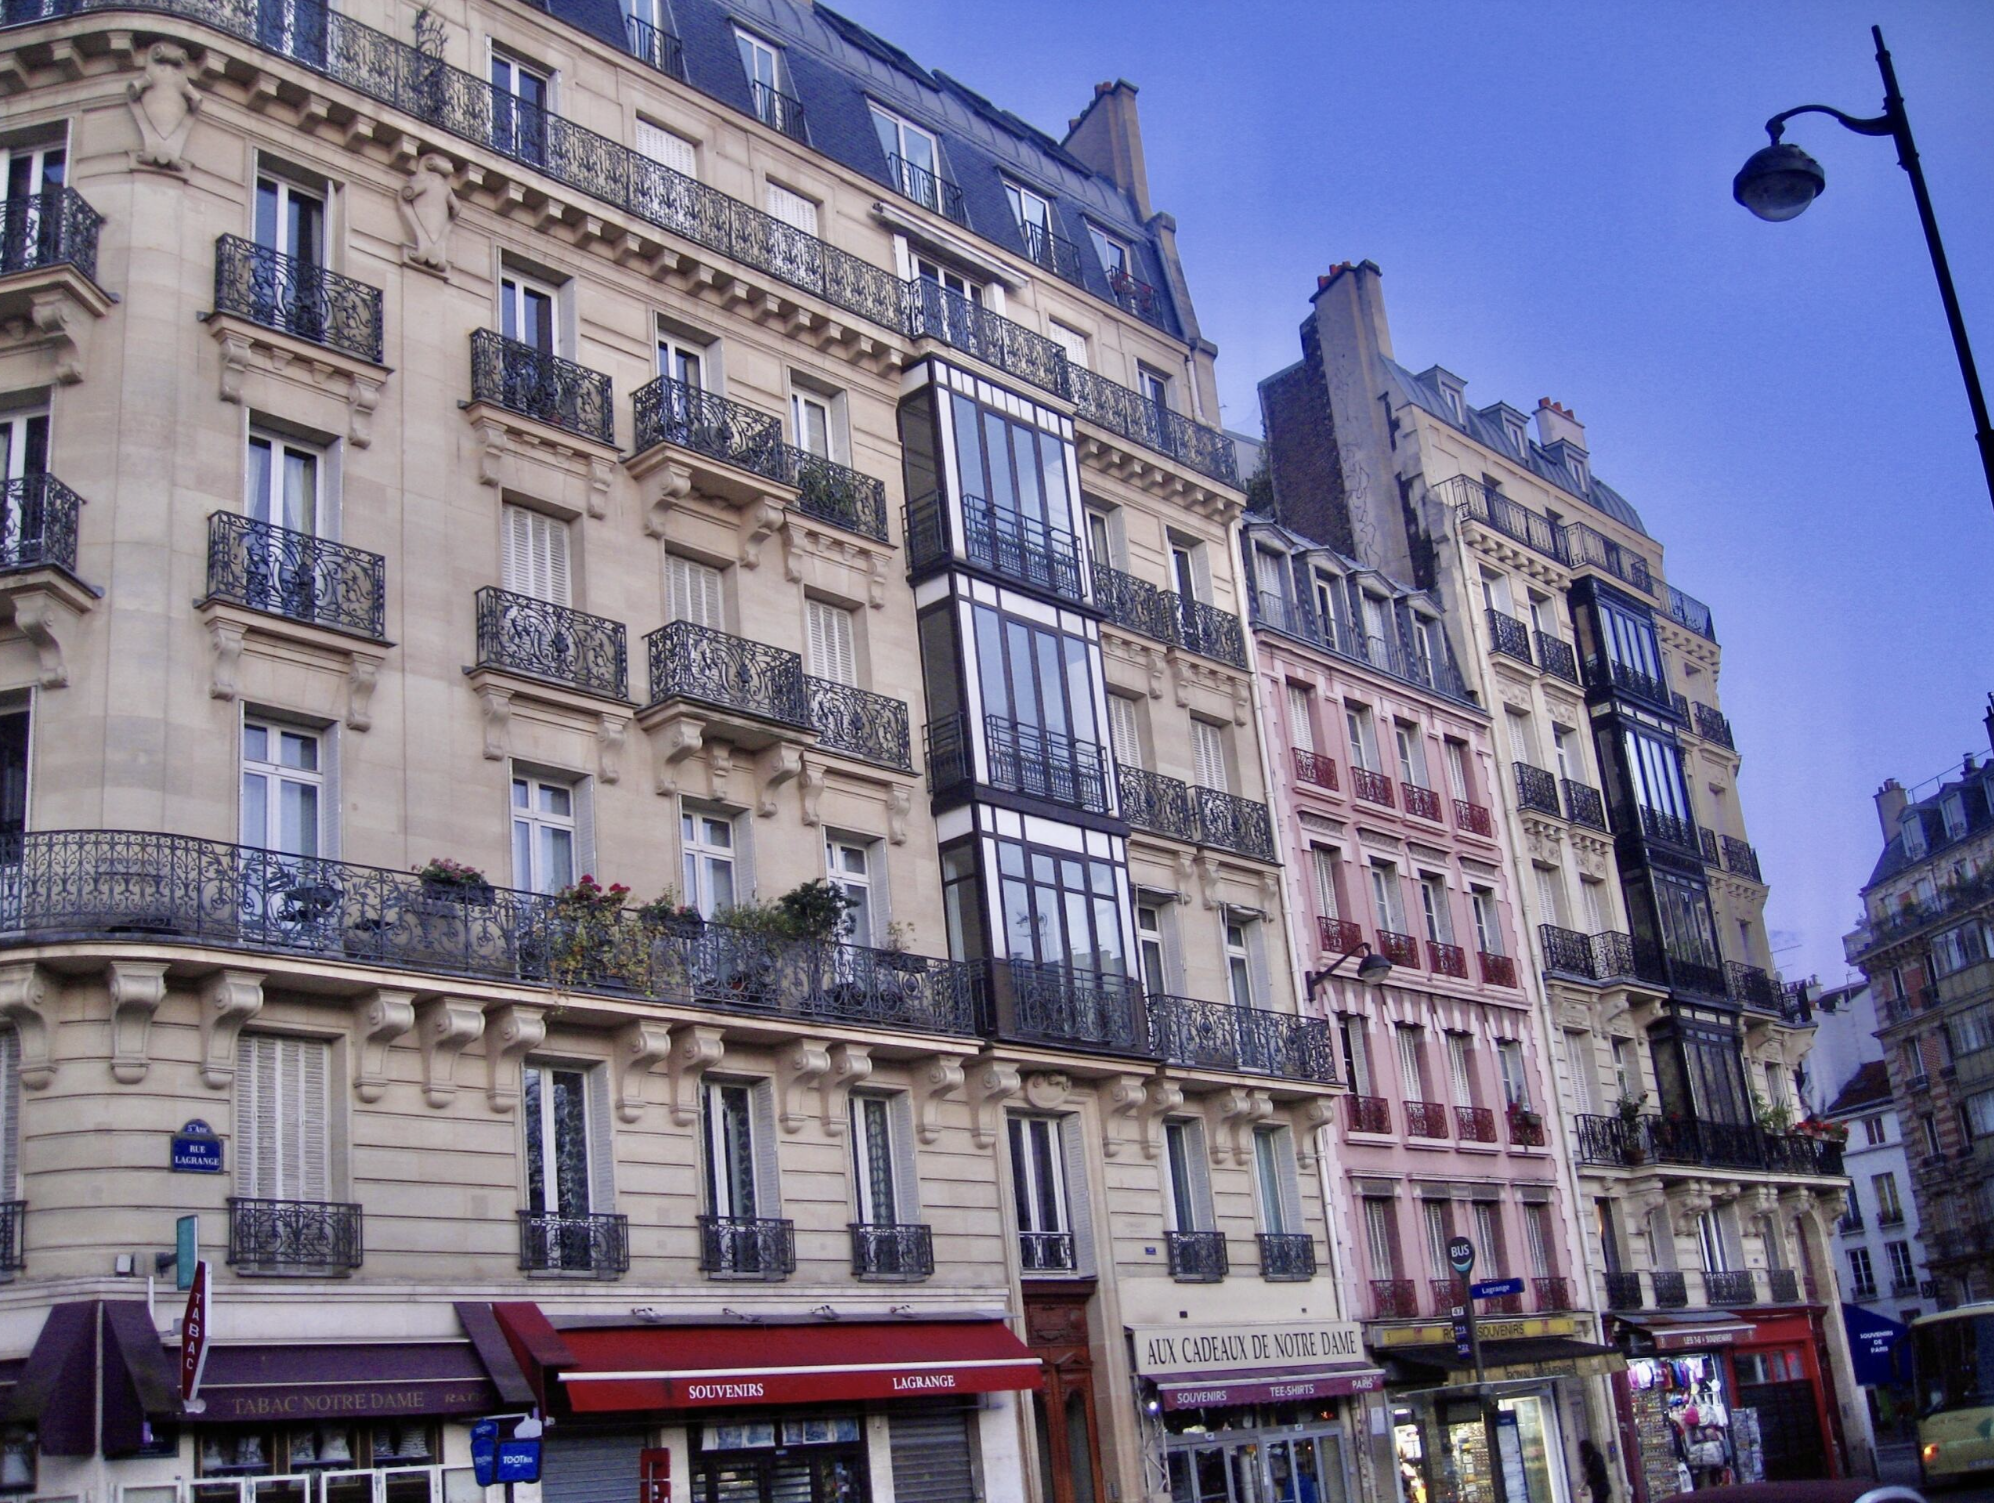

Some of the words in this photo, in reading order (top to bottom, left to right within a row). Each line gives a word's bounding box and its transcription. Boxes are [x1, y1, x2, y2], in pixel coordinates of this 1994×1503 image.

[189, 1145, 206, 1154] RUE
[175, 1156, 220, 1166] LAGRANGE
[1451, 1244, 1470, 1258] BUS
[1481, 1284, 1510, 1295] Lagrange
[1453, 1308, 1463, 1316] 47
[186, 1292, 202, 1370] TABAC
[1477, 1323, 1524, 1338] SOUVENIRS
[1148, 1337, 1177, 1365] AUX
[1181, 1335, 1248, 1363] CADEAUX
[1251, 1334, 1271, 1359] DE
[1273, 1332, 1318, 1358] NOTRE
[1321, 1330, 1357, 1355] DAME
[688, 1383, 764, 1399] SOUVENIRS
[892, 1375, 956, 1390] LAGRANGE
[1177, 1390, 1227, 1404] SOUVENIRS
[1270, 1384, 1314, 1397] TEE-SHIRTS
[1352, 1378, 1373, 1390] PARIS
[233, 1397, 300, 1415] TABAC
[302, 1393, 367, 1412] NOTRE
[370, 1392, 425, 1409] DAME
